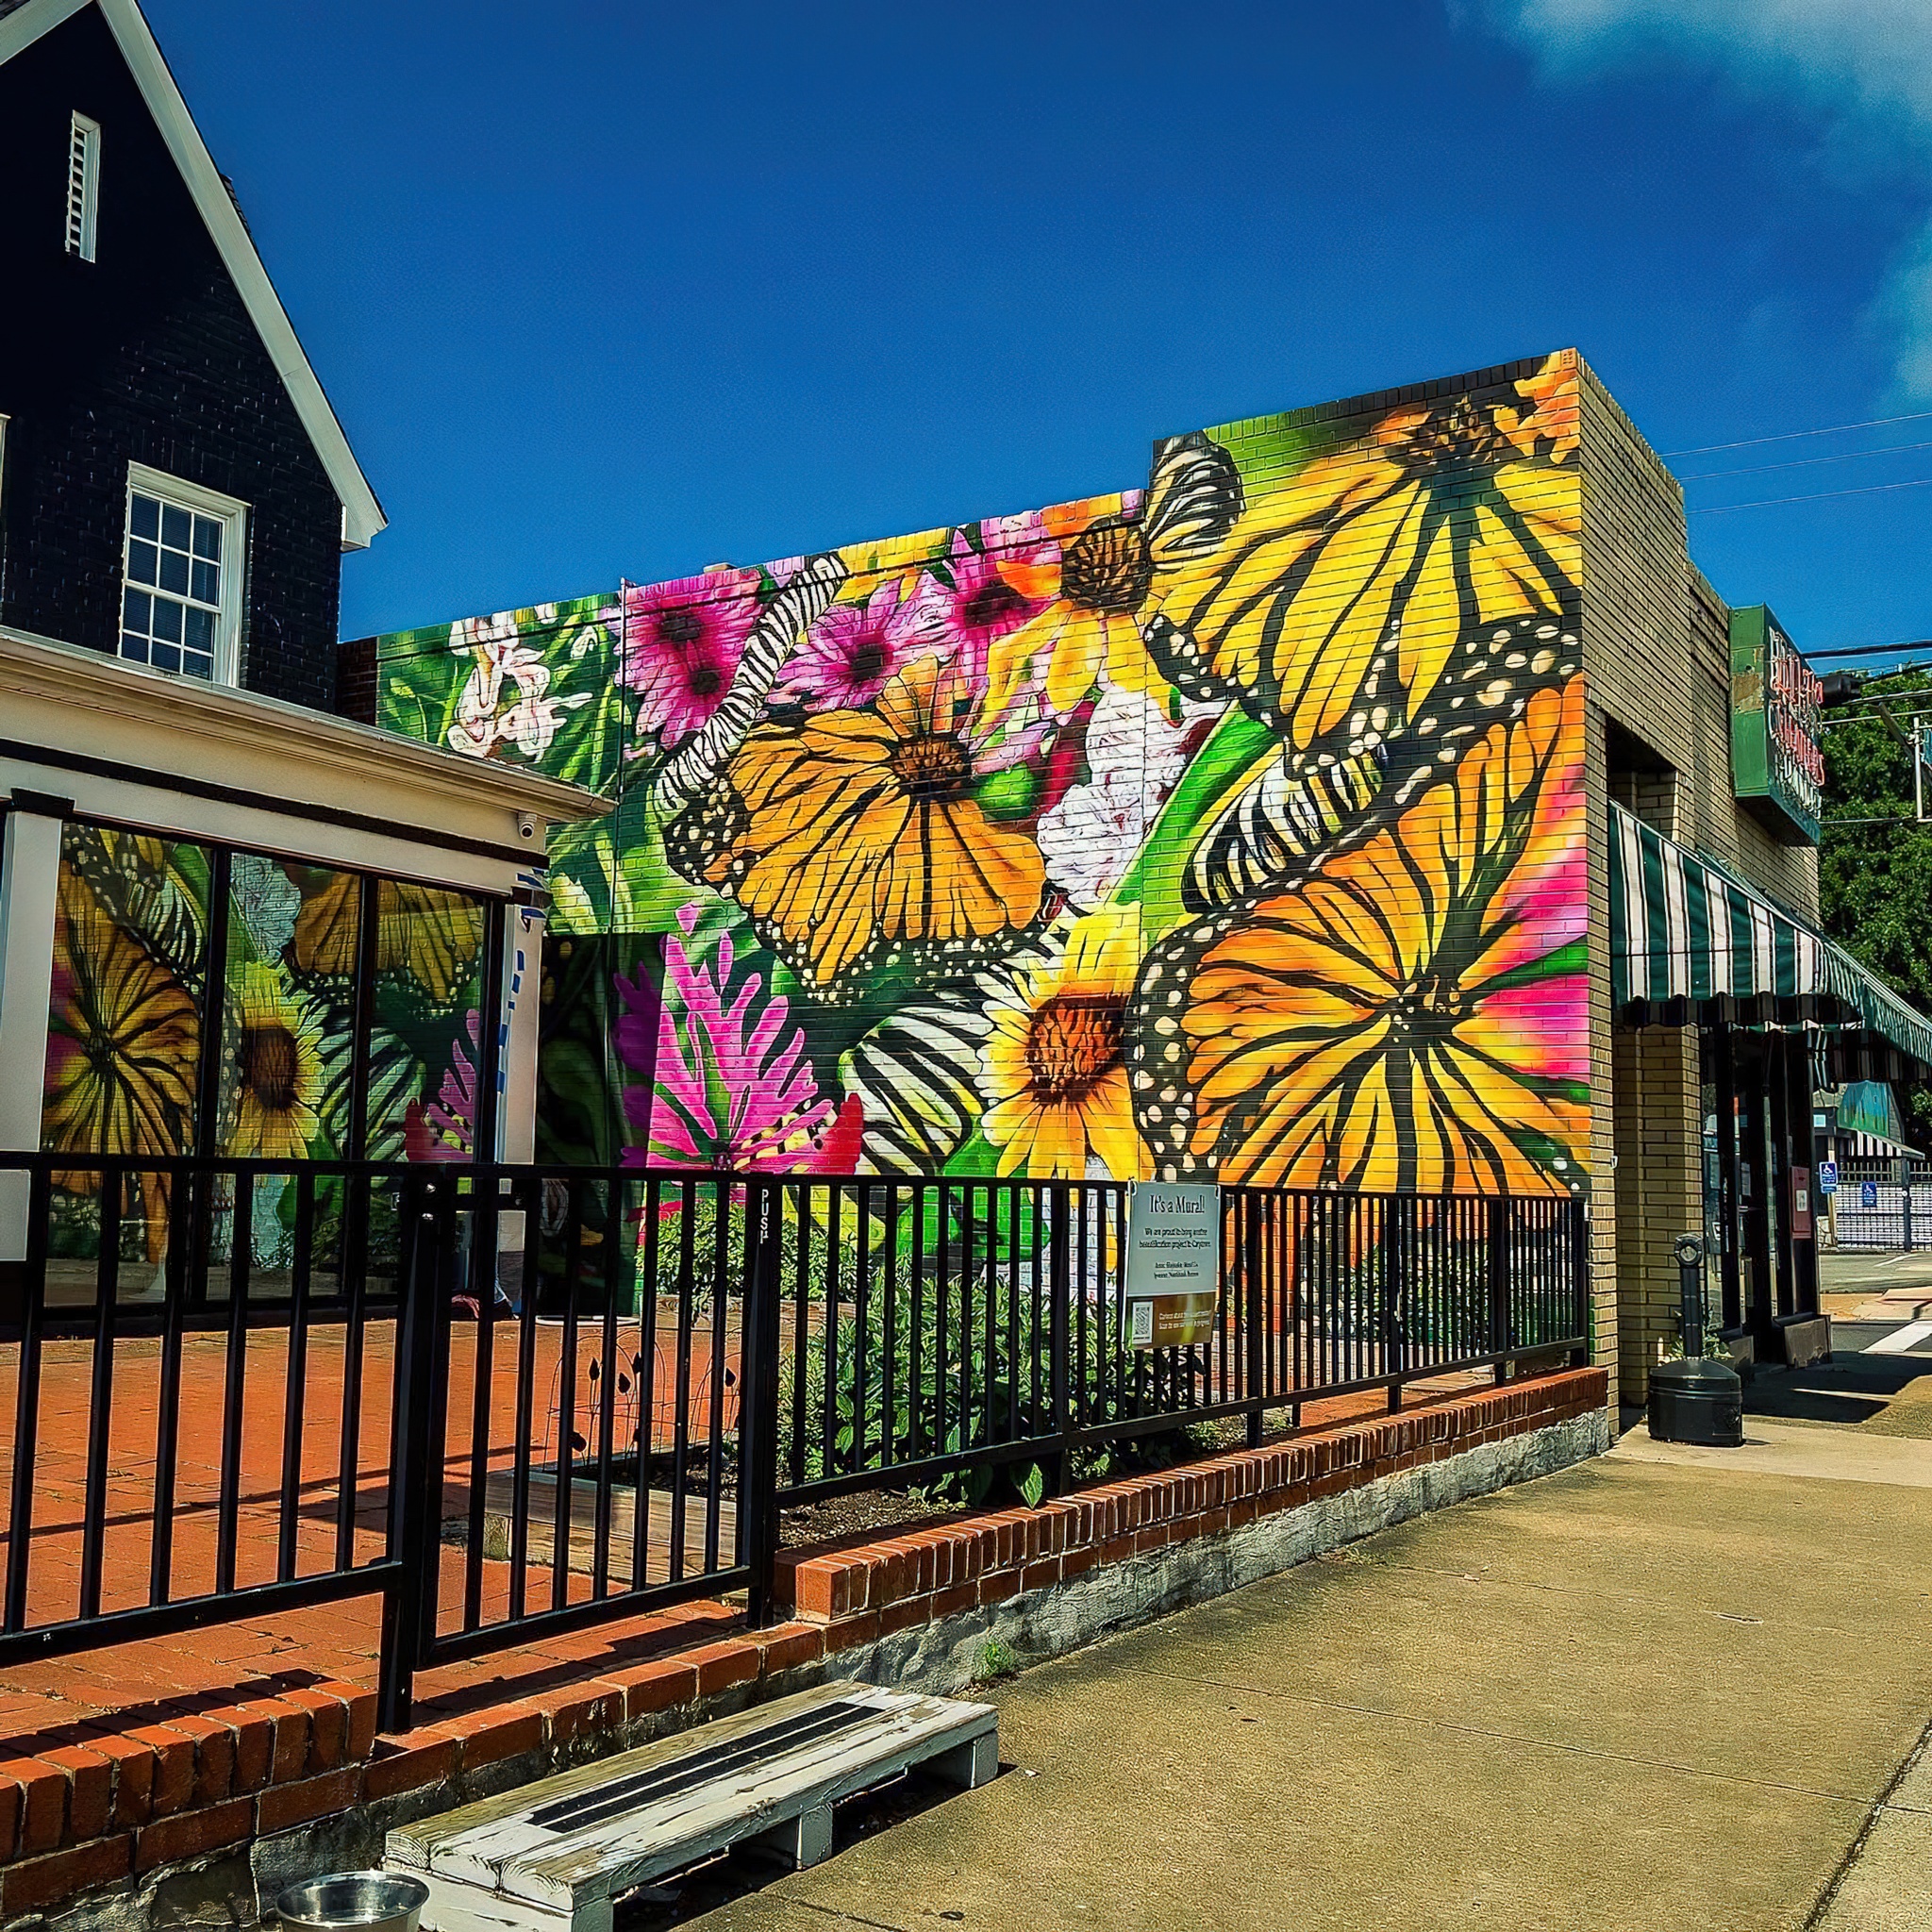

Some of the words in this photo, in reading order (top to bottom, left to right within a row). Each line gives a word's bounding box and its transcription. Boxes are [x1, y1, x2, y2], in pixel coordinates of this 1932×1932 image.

[759, 1189, 769, 1244] PUSH
[1150, 1194, 1165, 1213] It's
[1167, 1201, 1174, 1213] a
[1175, 1194, 1205, 1213] Mural!
